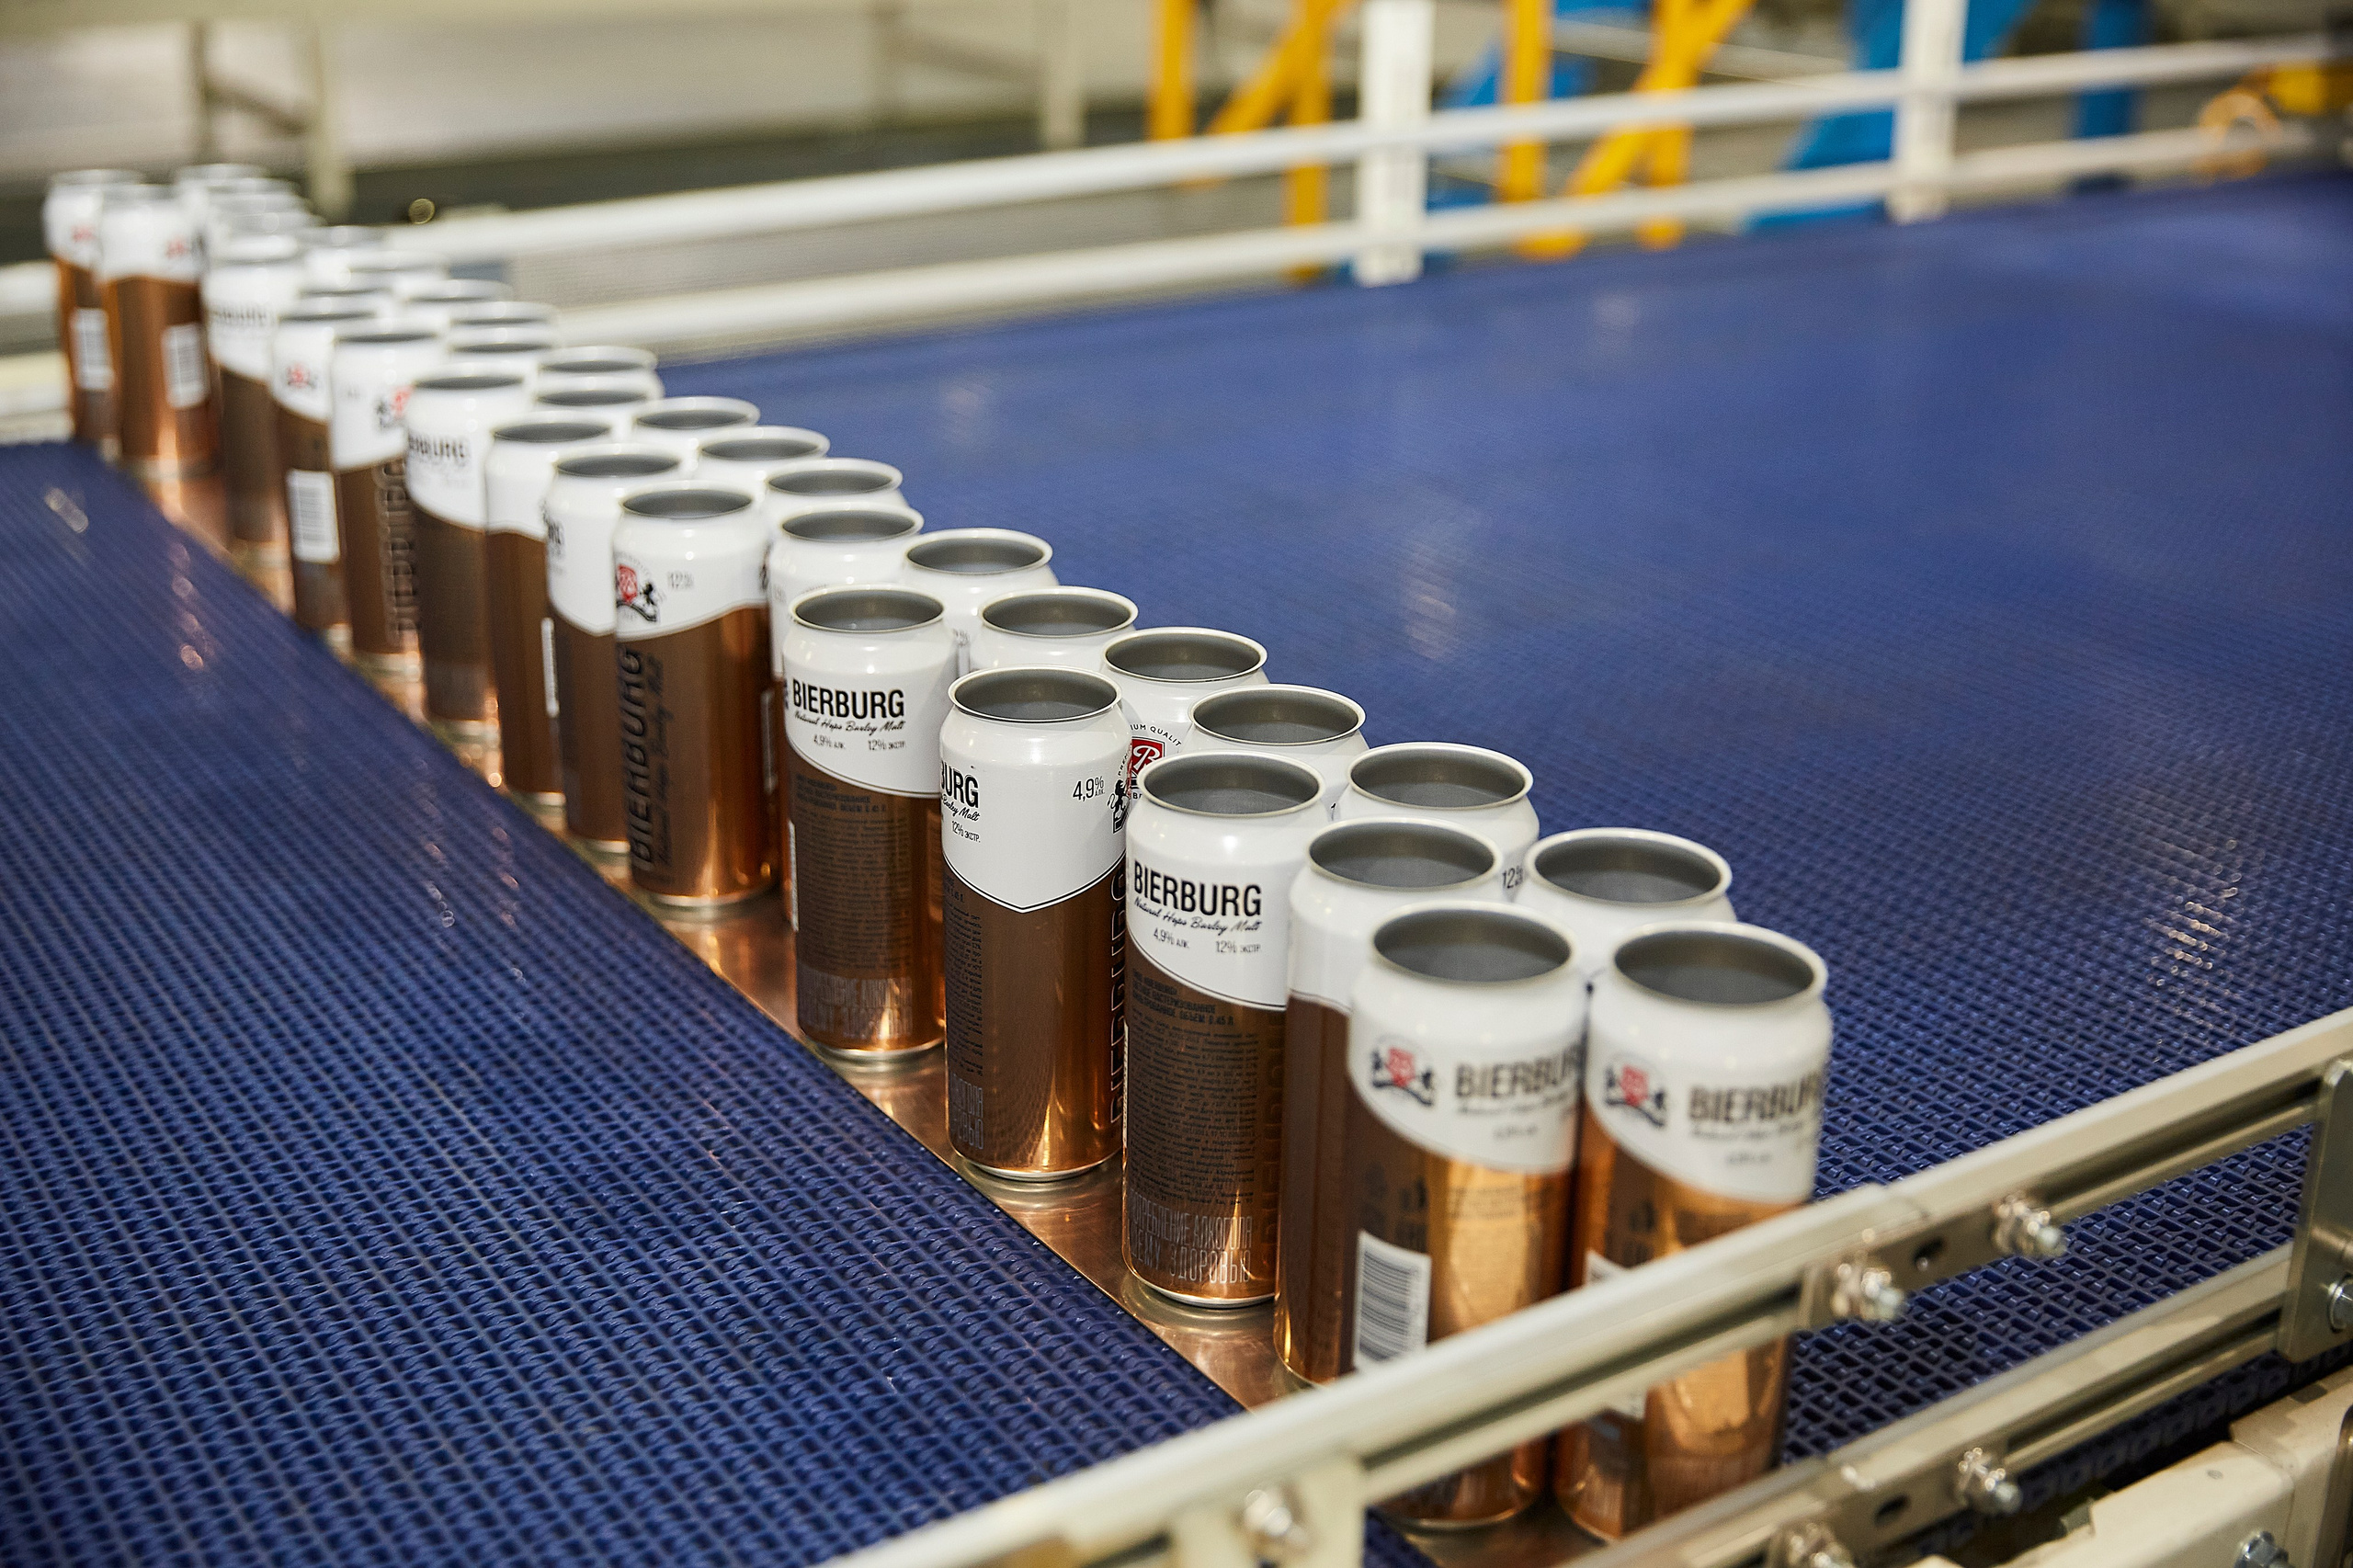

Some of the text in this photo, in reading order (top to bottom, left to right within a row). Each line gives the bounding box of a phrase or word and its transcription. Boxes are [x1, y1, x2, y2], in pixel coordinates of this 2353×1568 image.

[792, 678, 904, 719] BIERBURG
[845, 721, 878, 736] Barley
[880, 721, 906, 733] Malt
[1150, 725, 1182, 747] QUALIT
[1072, 776, 1105, 801] 4,9%
[959, 807, 981, 822] Malt
[1134, 859, 1261, 917] BIERBURG
[1134, 896, 1263, 937] Natural Hops Barley Malt
[1170, 1244, 1252, 1285] ЗДОРОВЬЮ
